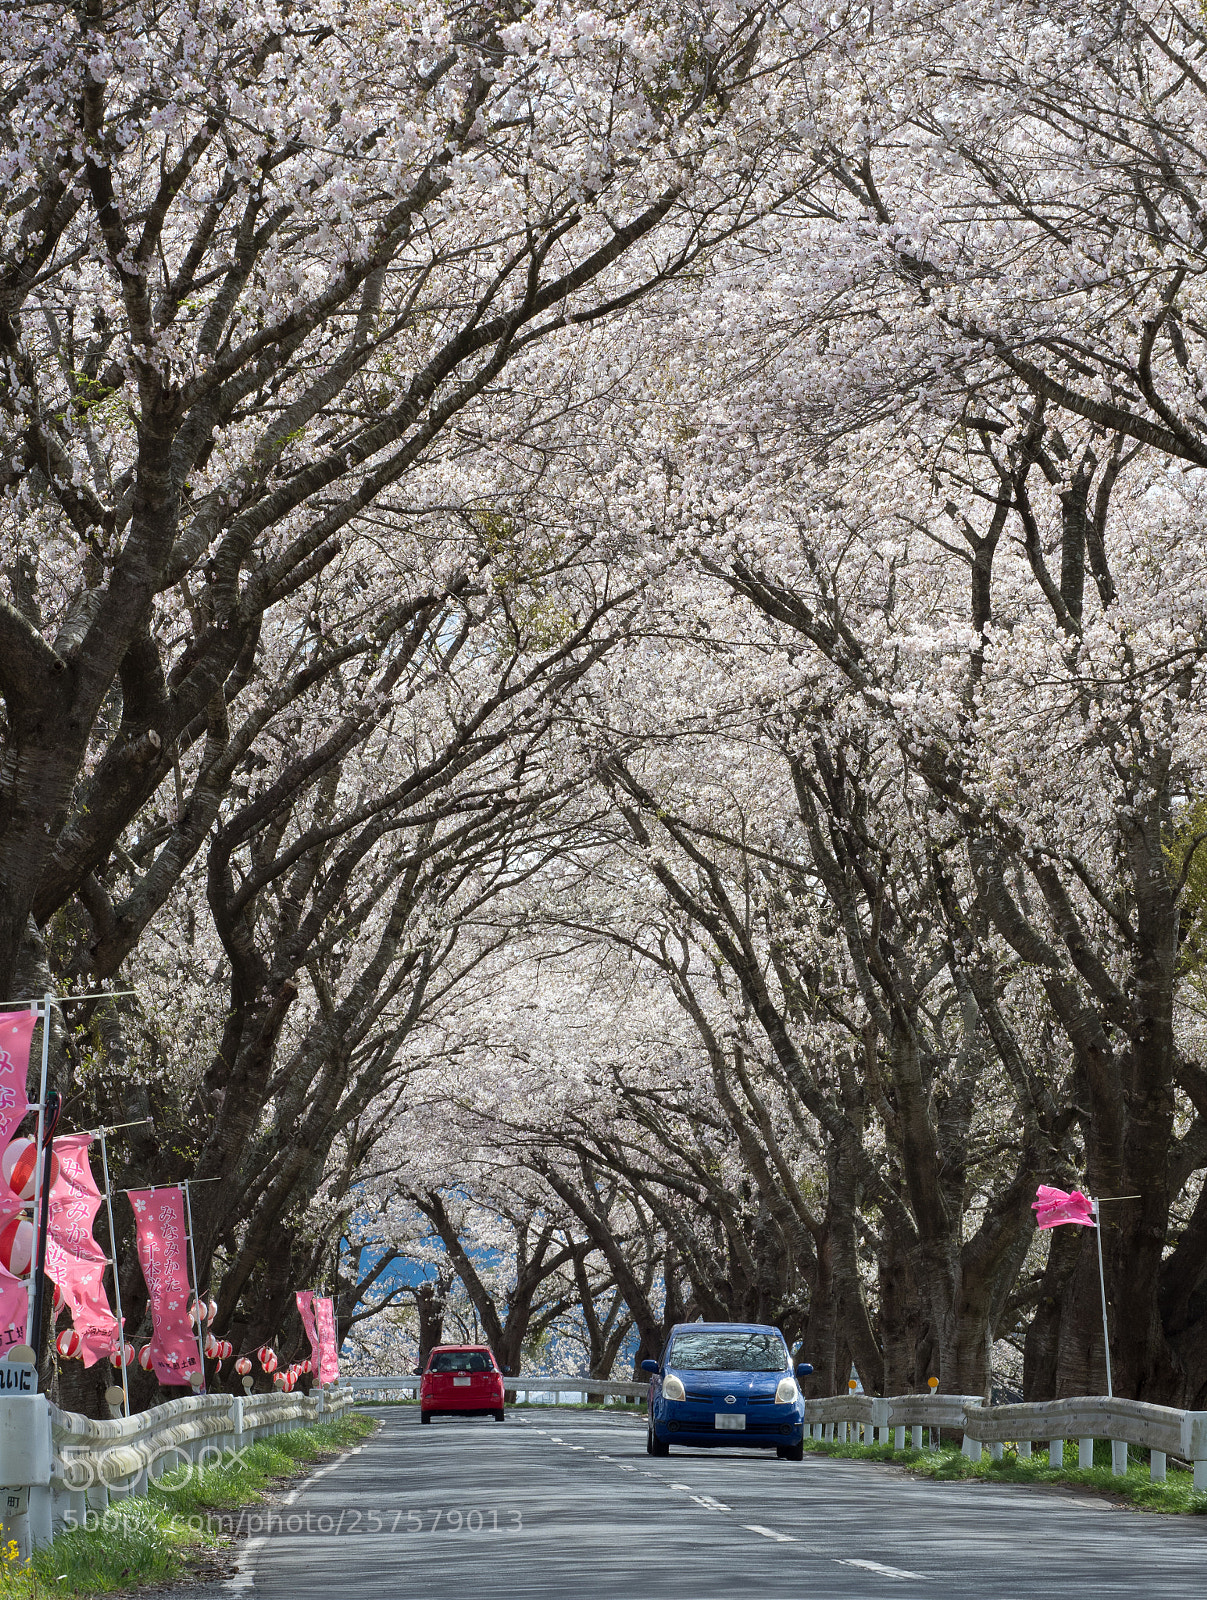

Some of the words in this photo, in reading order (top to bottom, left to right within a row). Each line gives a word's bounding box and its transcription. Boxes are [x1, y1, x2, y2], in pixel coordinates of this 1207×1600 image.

[63, 1157, 96, 1262] みなみかた
[159, 1205, 183, 1293] みなみかた
